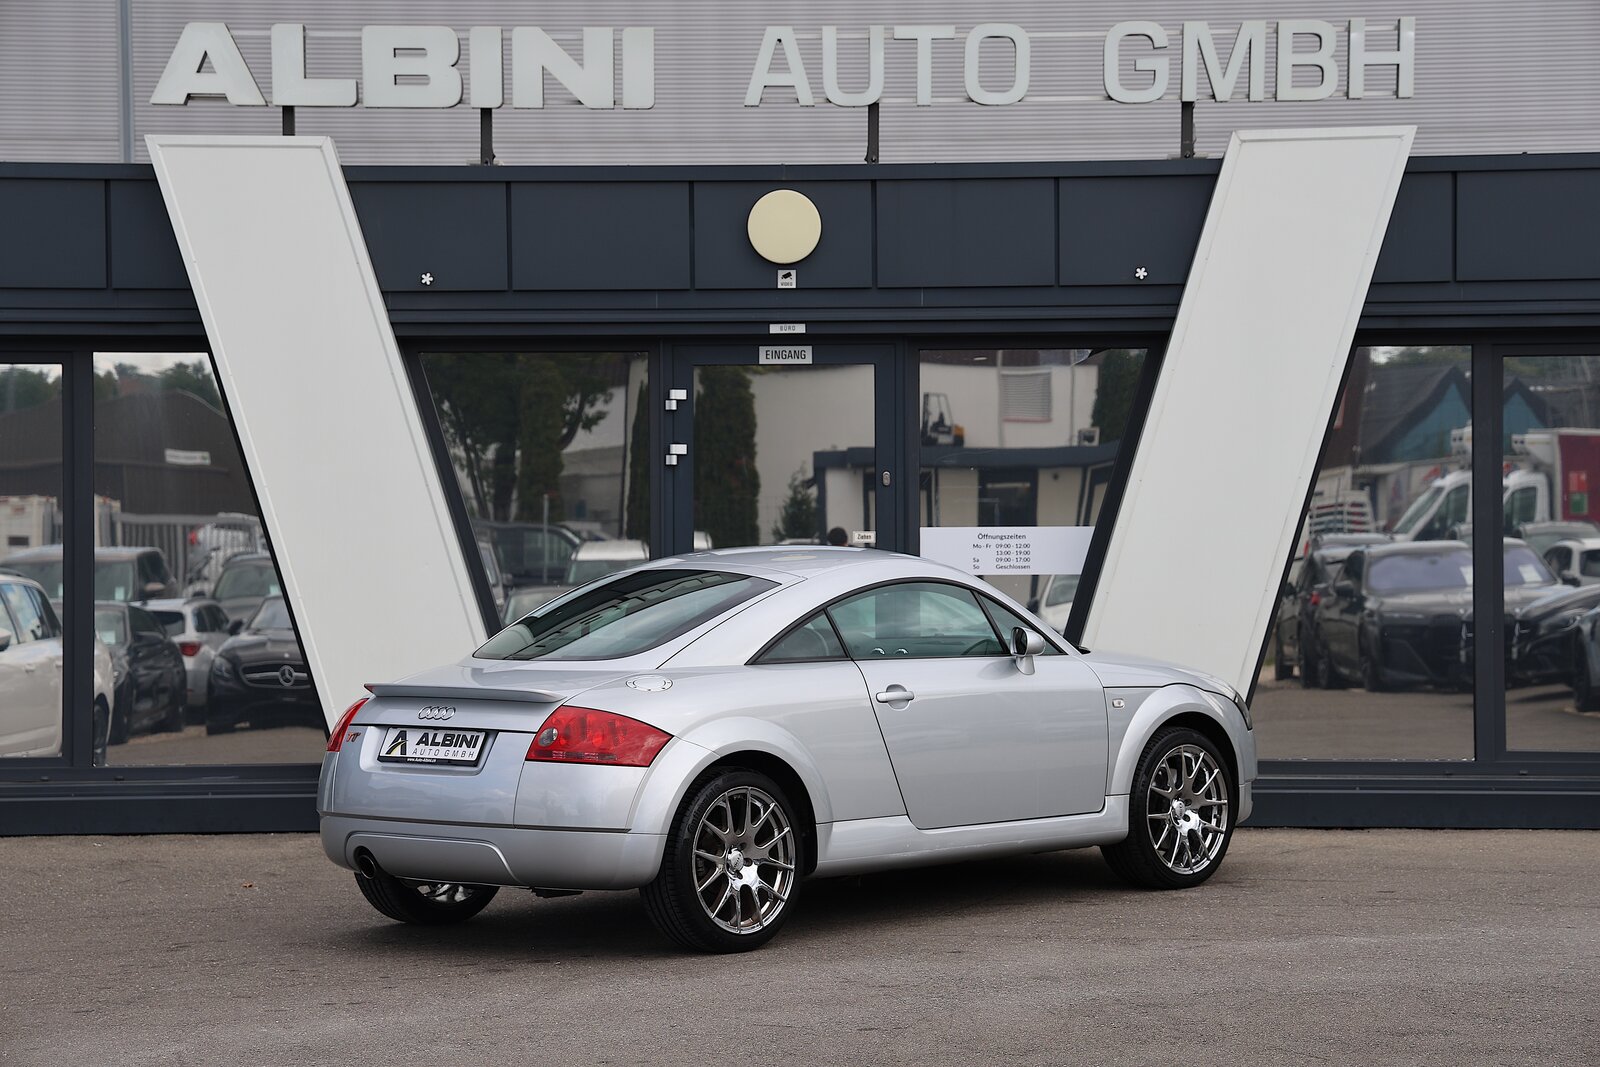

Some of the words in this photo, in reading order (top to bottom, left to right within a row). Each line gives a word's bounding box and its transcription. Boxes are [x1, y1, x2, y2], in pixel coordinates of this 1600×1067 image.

[150, 22, 655, 109] ALBINI
[744, 23, 1031, 107] AUTO
[1103, 16, 1416, 104] GMBH
[765, 349, 806, 360] EINGANG
[977, 532, 1026, 541] Öffnungszeiten
[416, 732, 480, 749] ALBINI
[412, 748, 440, 757] AUTO
[444, 749, 476, 758] GMBH
